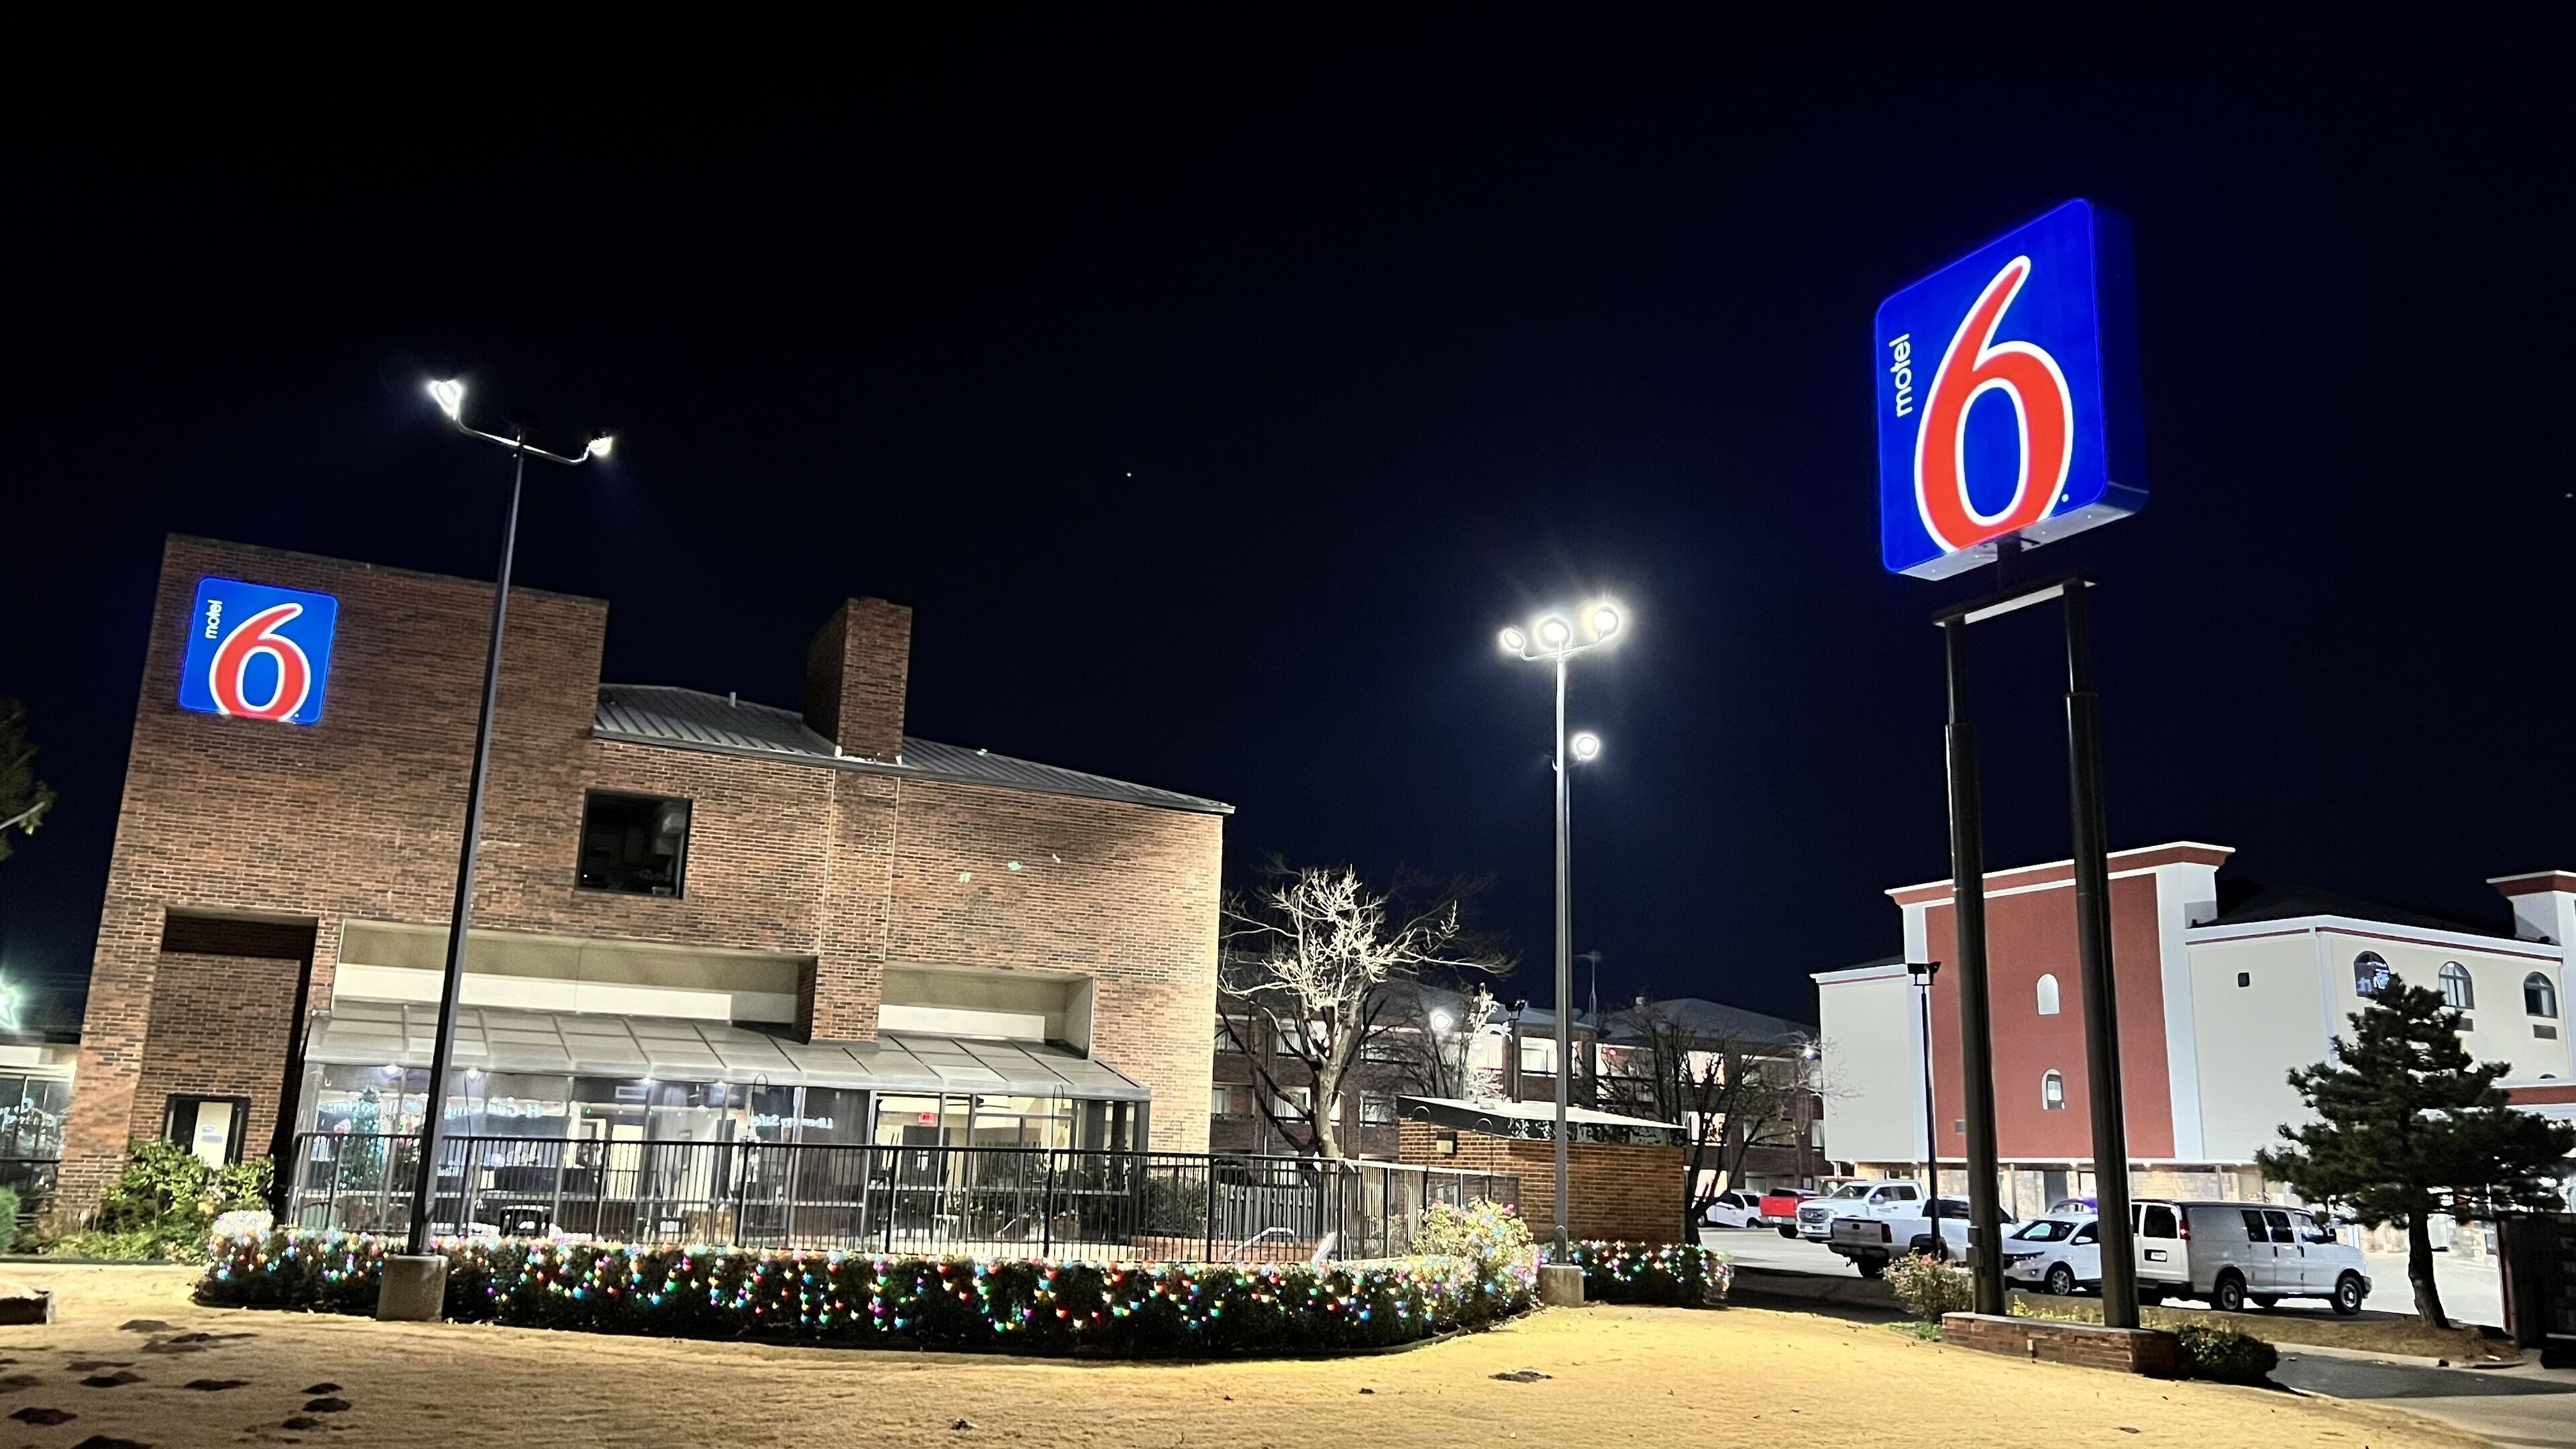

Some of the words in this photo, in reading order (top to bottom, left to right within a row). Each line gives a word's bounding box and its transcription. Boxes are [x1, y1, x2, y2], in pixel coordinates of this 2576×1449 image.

[1889, 333, 1913, 417] motel
[1914, 255, 2074, 553] 6
[205, 600, 223, 639] motel
[209, 602, 311, 721] 6
